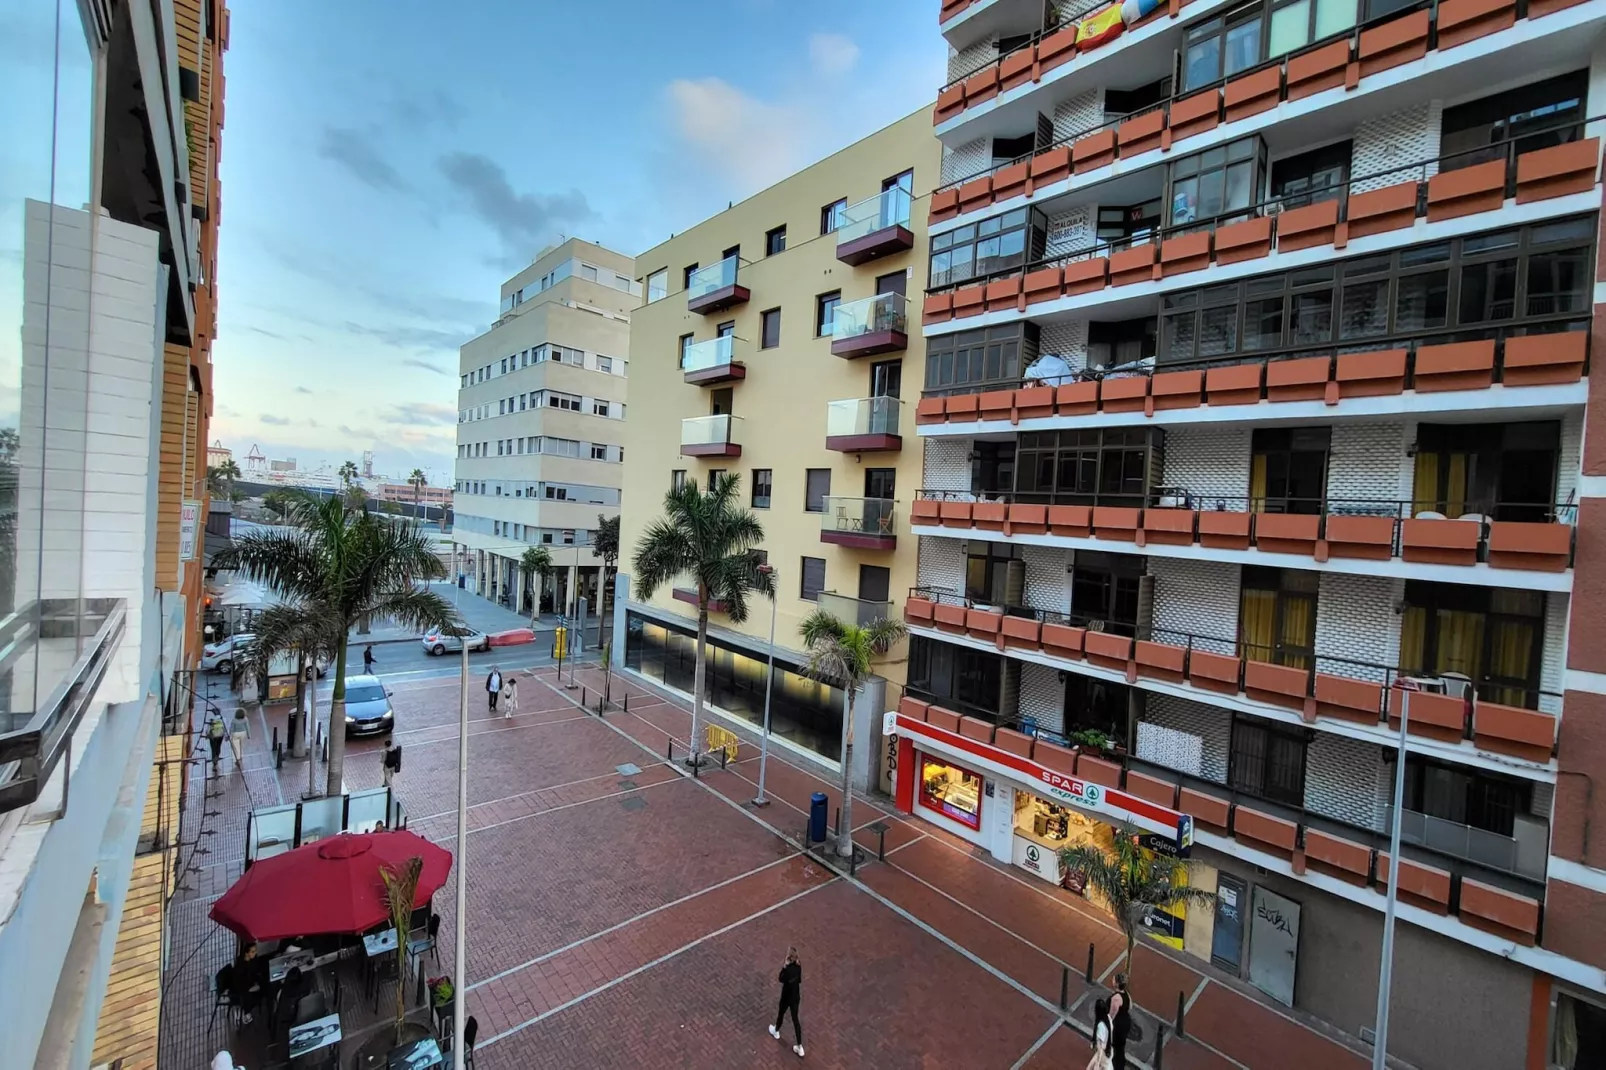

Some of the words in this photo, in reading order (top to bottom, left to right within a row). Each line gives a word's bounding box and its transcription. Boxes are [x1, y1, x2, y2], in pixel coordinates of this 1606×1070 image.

[1060, 217, 1083, 228] ALQUILA
[1042, 771, 1083, 794] SPAR
[1050, 787, 1098, 806] express
[1150, 837, 1177, 853] Cajero
[1146, 912, 1171, 927] uronet
